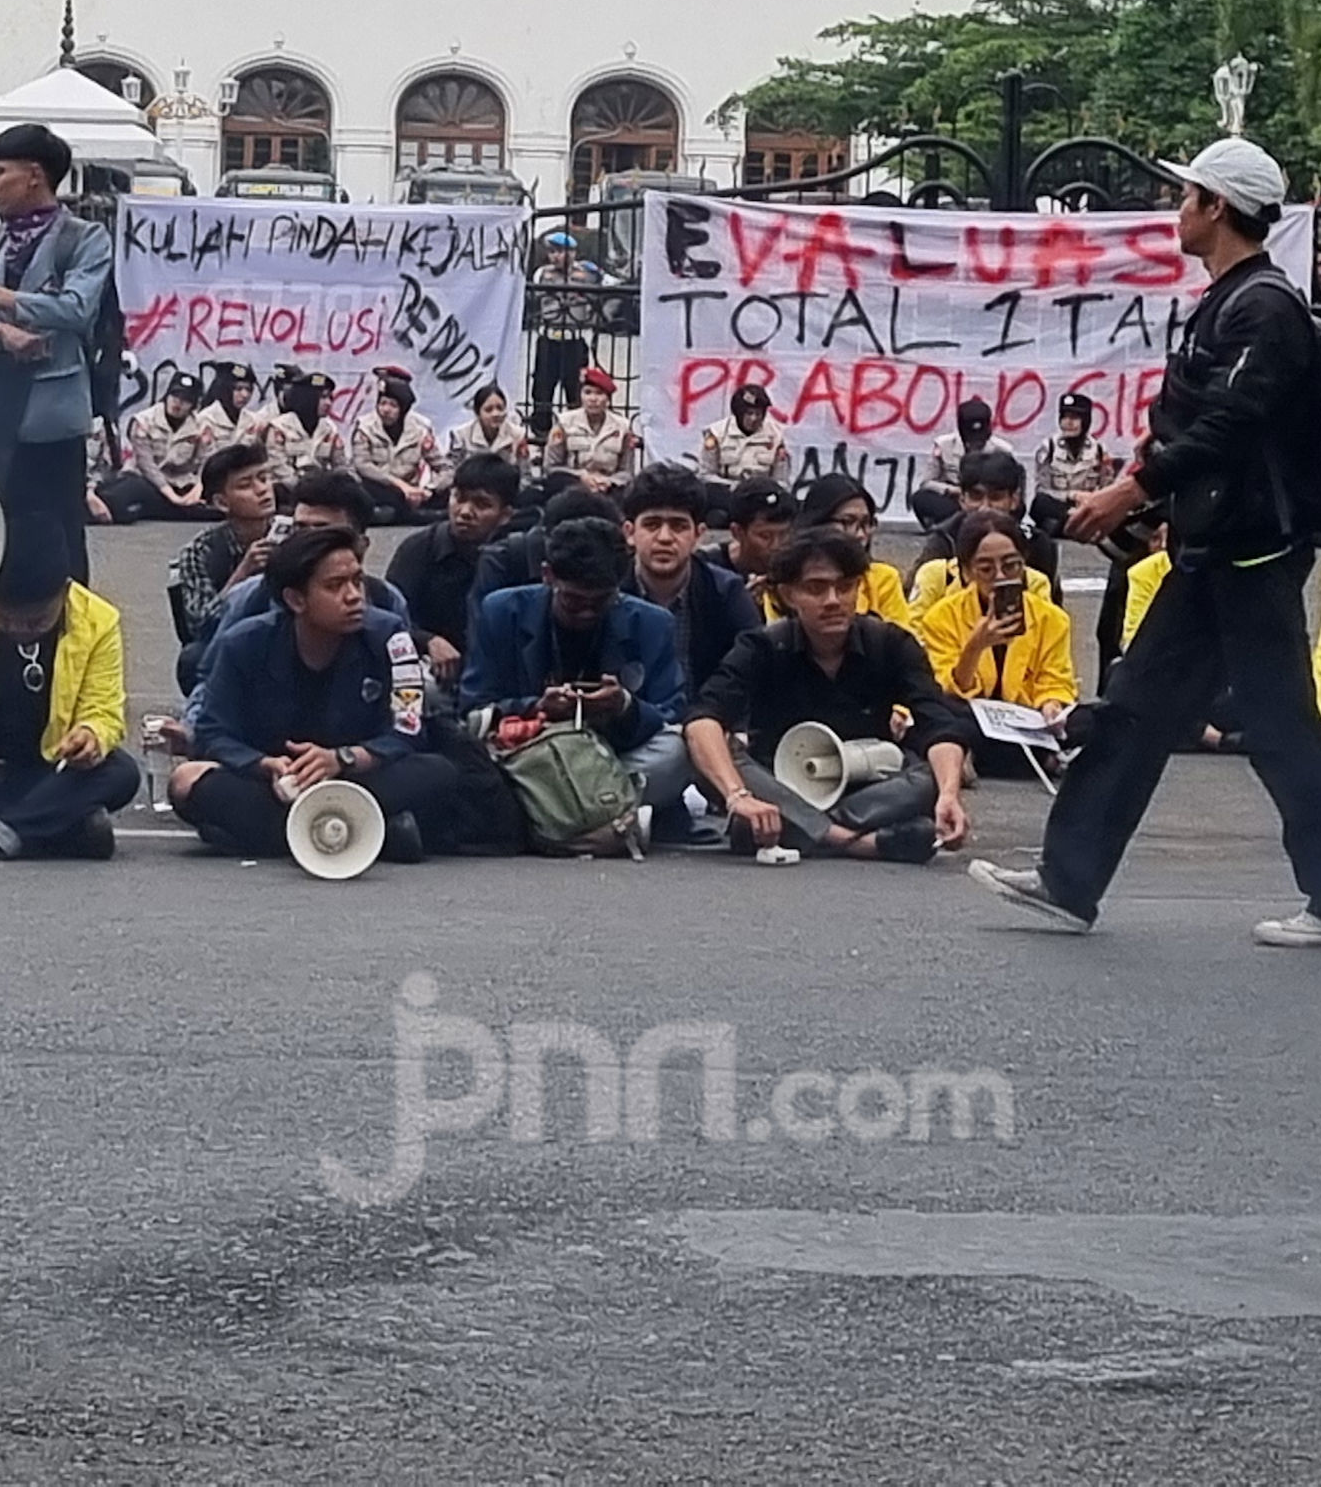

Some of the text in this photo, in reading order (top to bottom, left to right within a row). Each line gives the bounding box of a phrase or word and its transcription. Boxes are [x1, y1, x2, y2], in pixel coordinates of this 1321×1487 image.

[124, 209, 254, 271] KULIAH
[665, 200, 1206, 298] EVALUAS
[658, 286, 1186, 358] TOTAL 1 TAH
